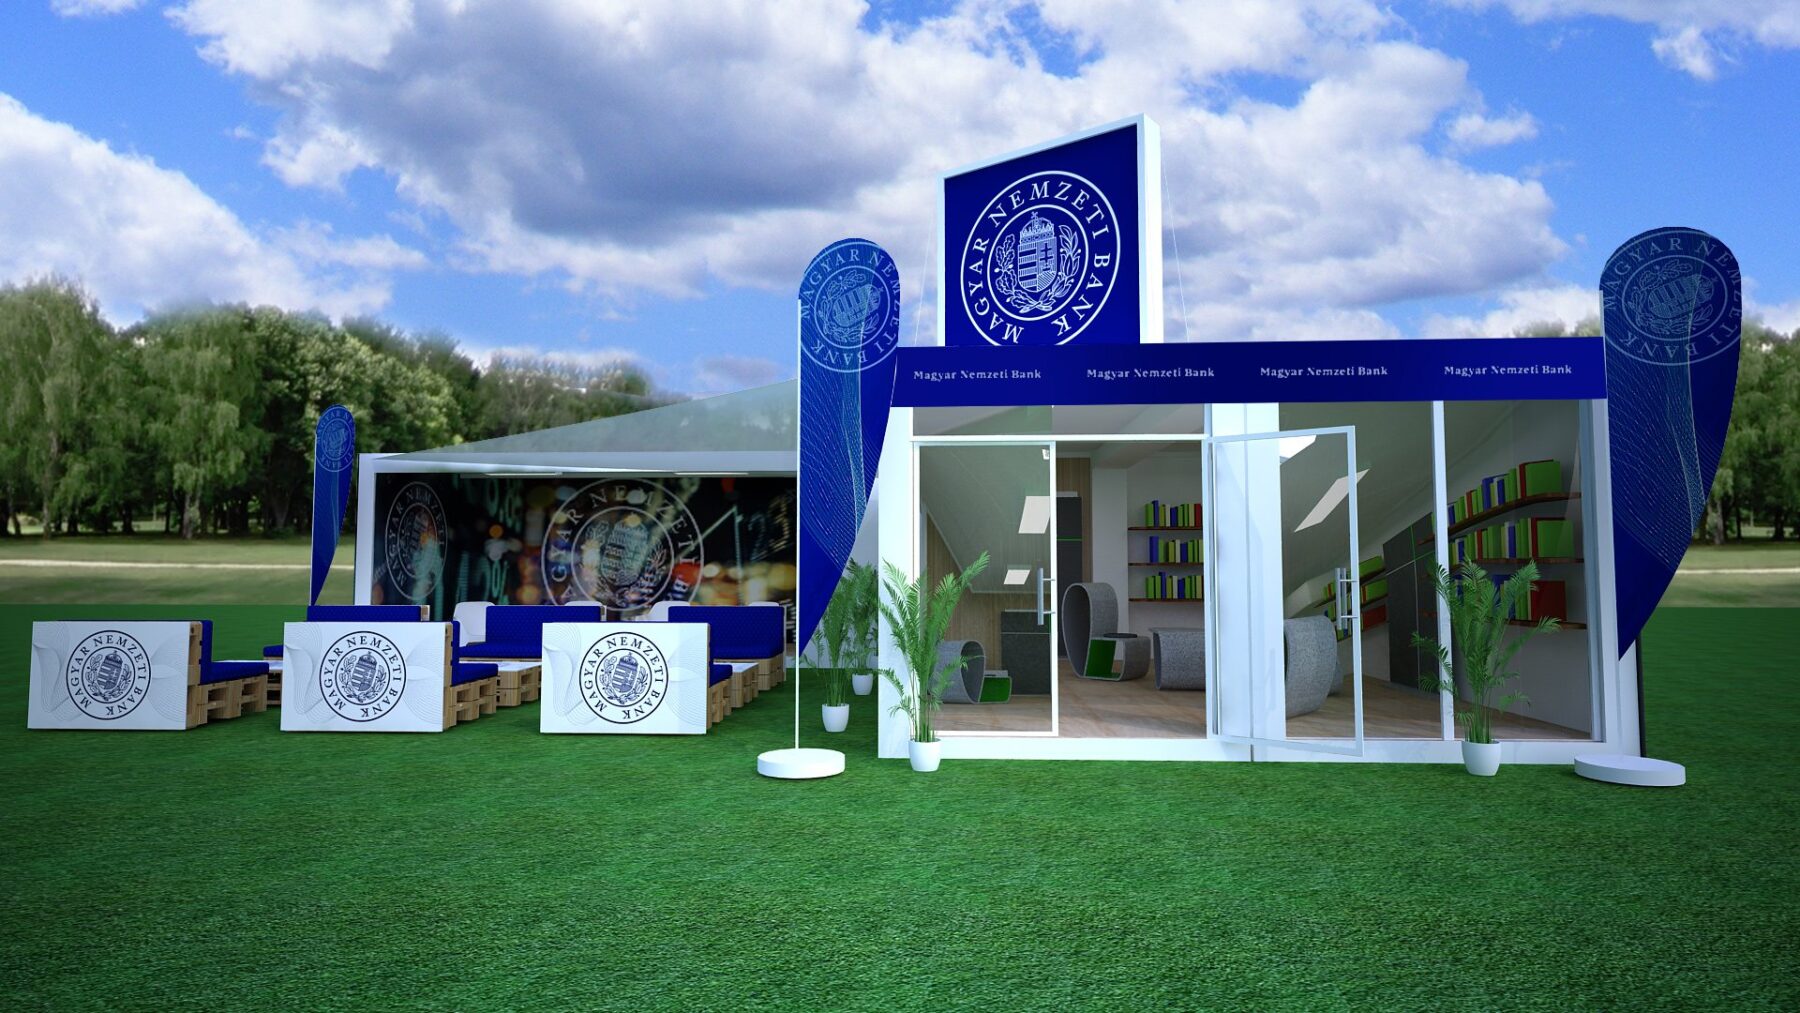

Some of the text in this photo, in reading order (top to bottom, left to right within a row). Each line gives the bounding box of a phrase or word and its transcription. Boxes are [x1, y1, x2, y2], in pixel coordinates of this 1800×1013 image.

[800, 249, 861, 319] MAGYAR
[968, 180, 1111, 344] MAGYAR NEMZETI BANK
[1603, 237, 1684, 311] MAGYAR
[810, 340, 869, 366] BANK
[1619, 332, 1699, 359] BANK
[913, 369, 1042, 382] Magyar Nemzeti Bank
[1086, 367, 1215, 380] Magyar Nemzeti Bank
[1260, 365, 1388, 379] Magyar Nemzeti Bank
[1443, 364, 1572, 378] Magyar Nemzeti Bank
[70, 634, 147, 716] MAGYAR NEMZETI BANK
[323, 635, 402, 718] MAGYAR NEMZETI BANK
[583, 636, 664, 720] MAGYAR NEMZETI BANK
